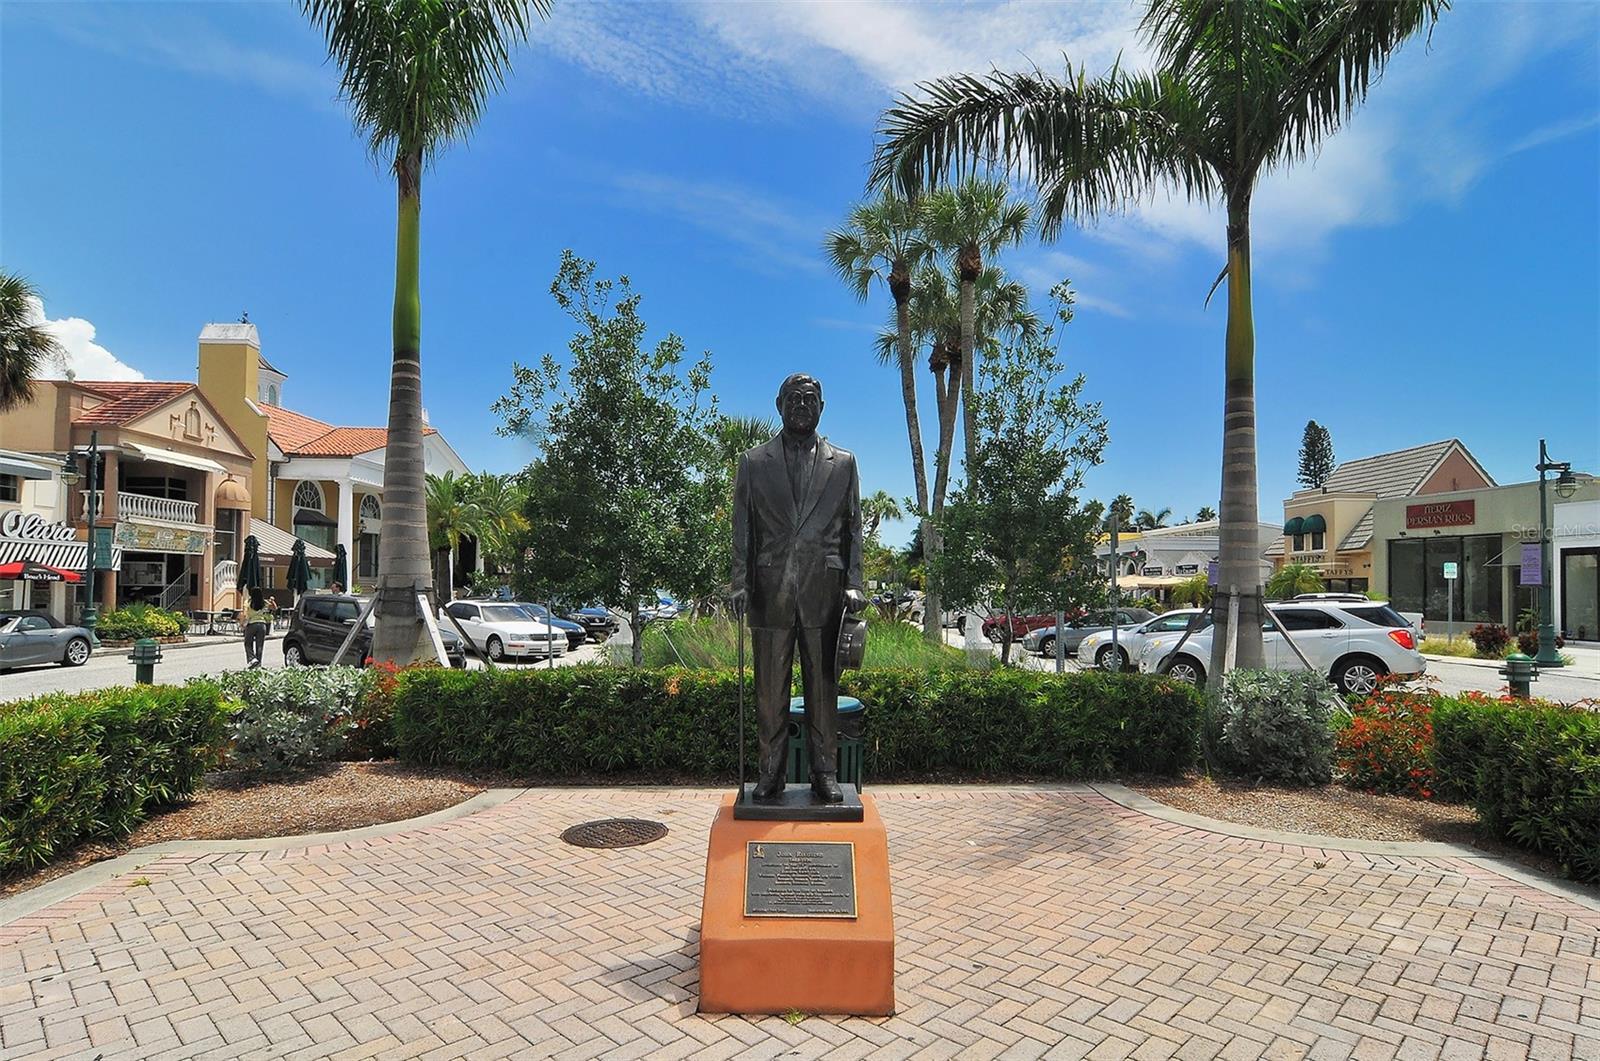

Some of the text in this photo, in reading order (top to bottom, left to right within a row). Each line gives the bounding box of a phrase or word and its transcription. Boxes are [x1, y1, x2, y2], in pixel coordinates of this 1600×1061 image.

[1, 510, 76, 541] Olivia
[1407, 513, 1473, 526] PERSIAN RUGS
